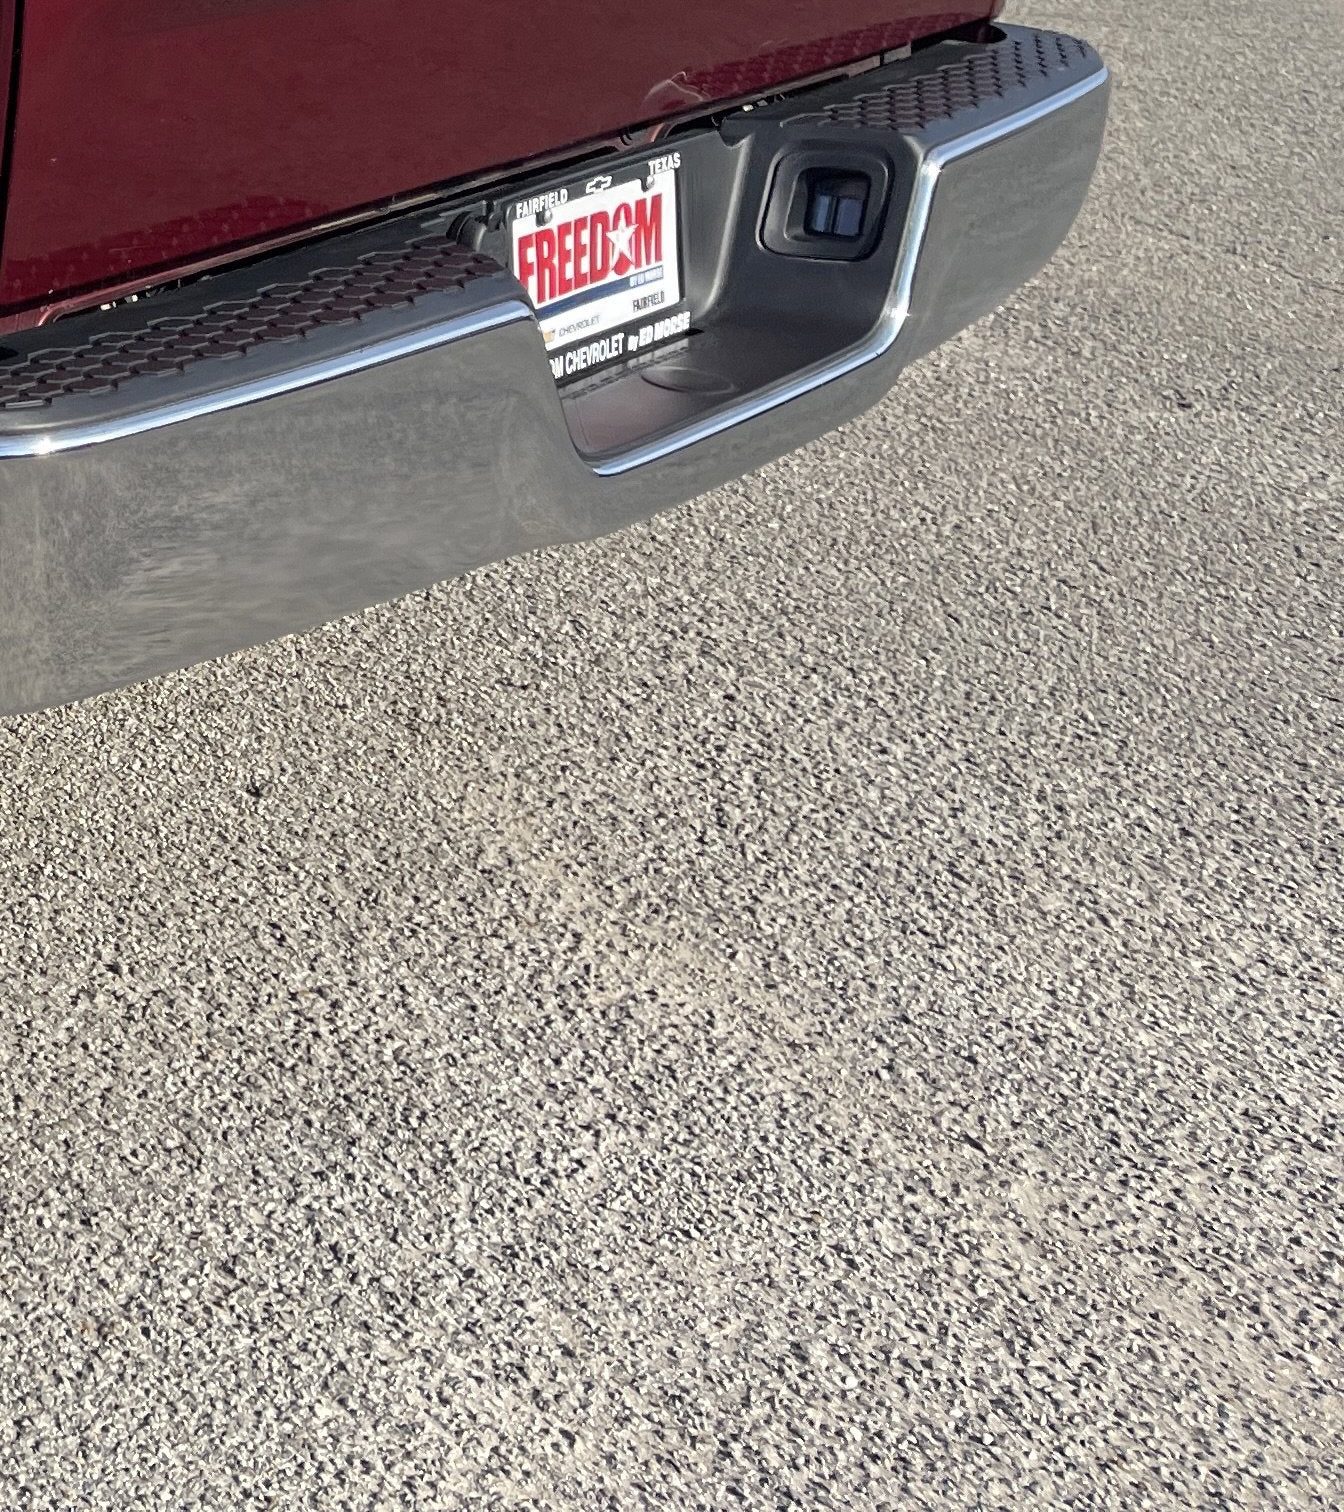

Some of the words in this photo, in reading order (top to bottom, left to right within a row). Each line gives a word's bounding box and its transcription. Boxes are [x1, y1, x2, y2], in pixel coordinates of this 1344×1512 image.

[515, 188, 569, 219] FAIRFIELD
[647, 152, 682, 177] TEXAS
[518, 192, 663, 305] FREEDOM
[565, 332, 625, 375] CHEVROLET
[639, 324, 654, 347] ED
[653, 311, 691, 342] MORSE
